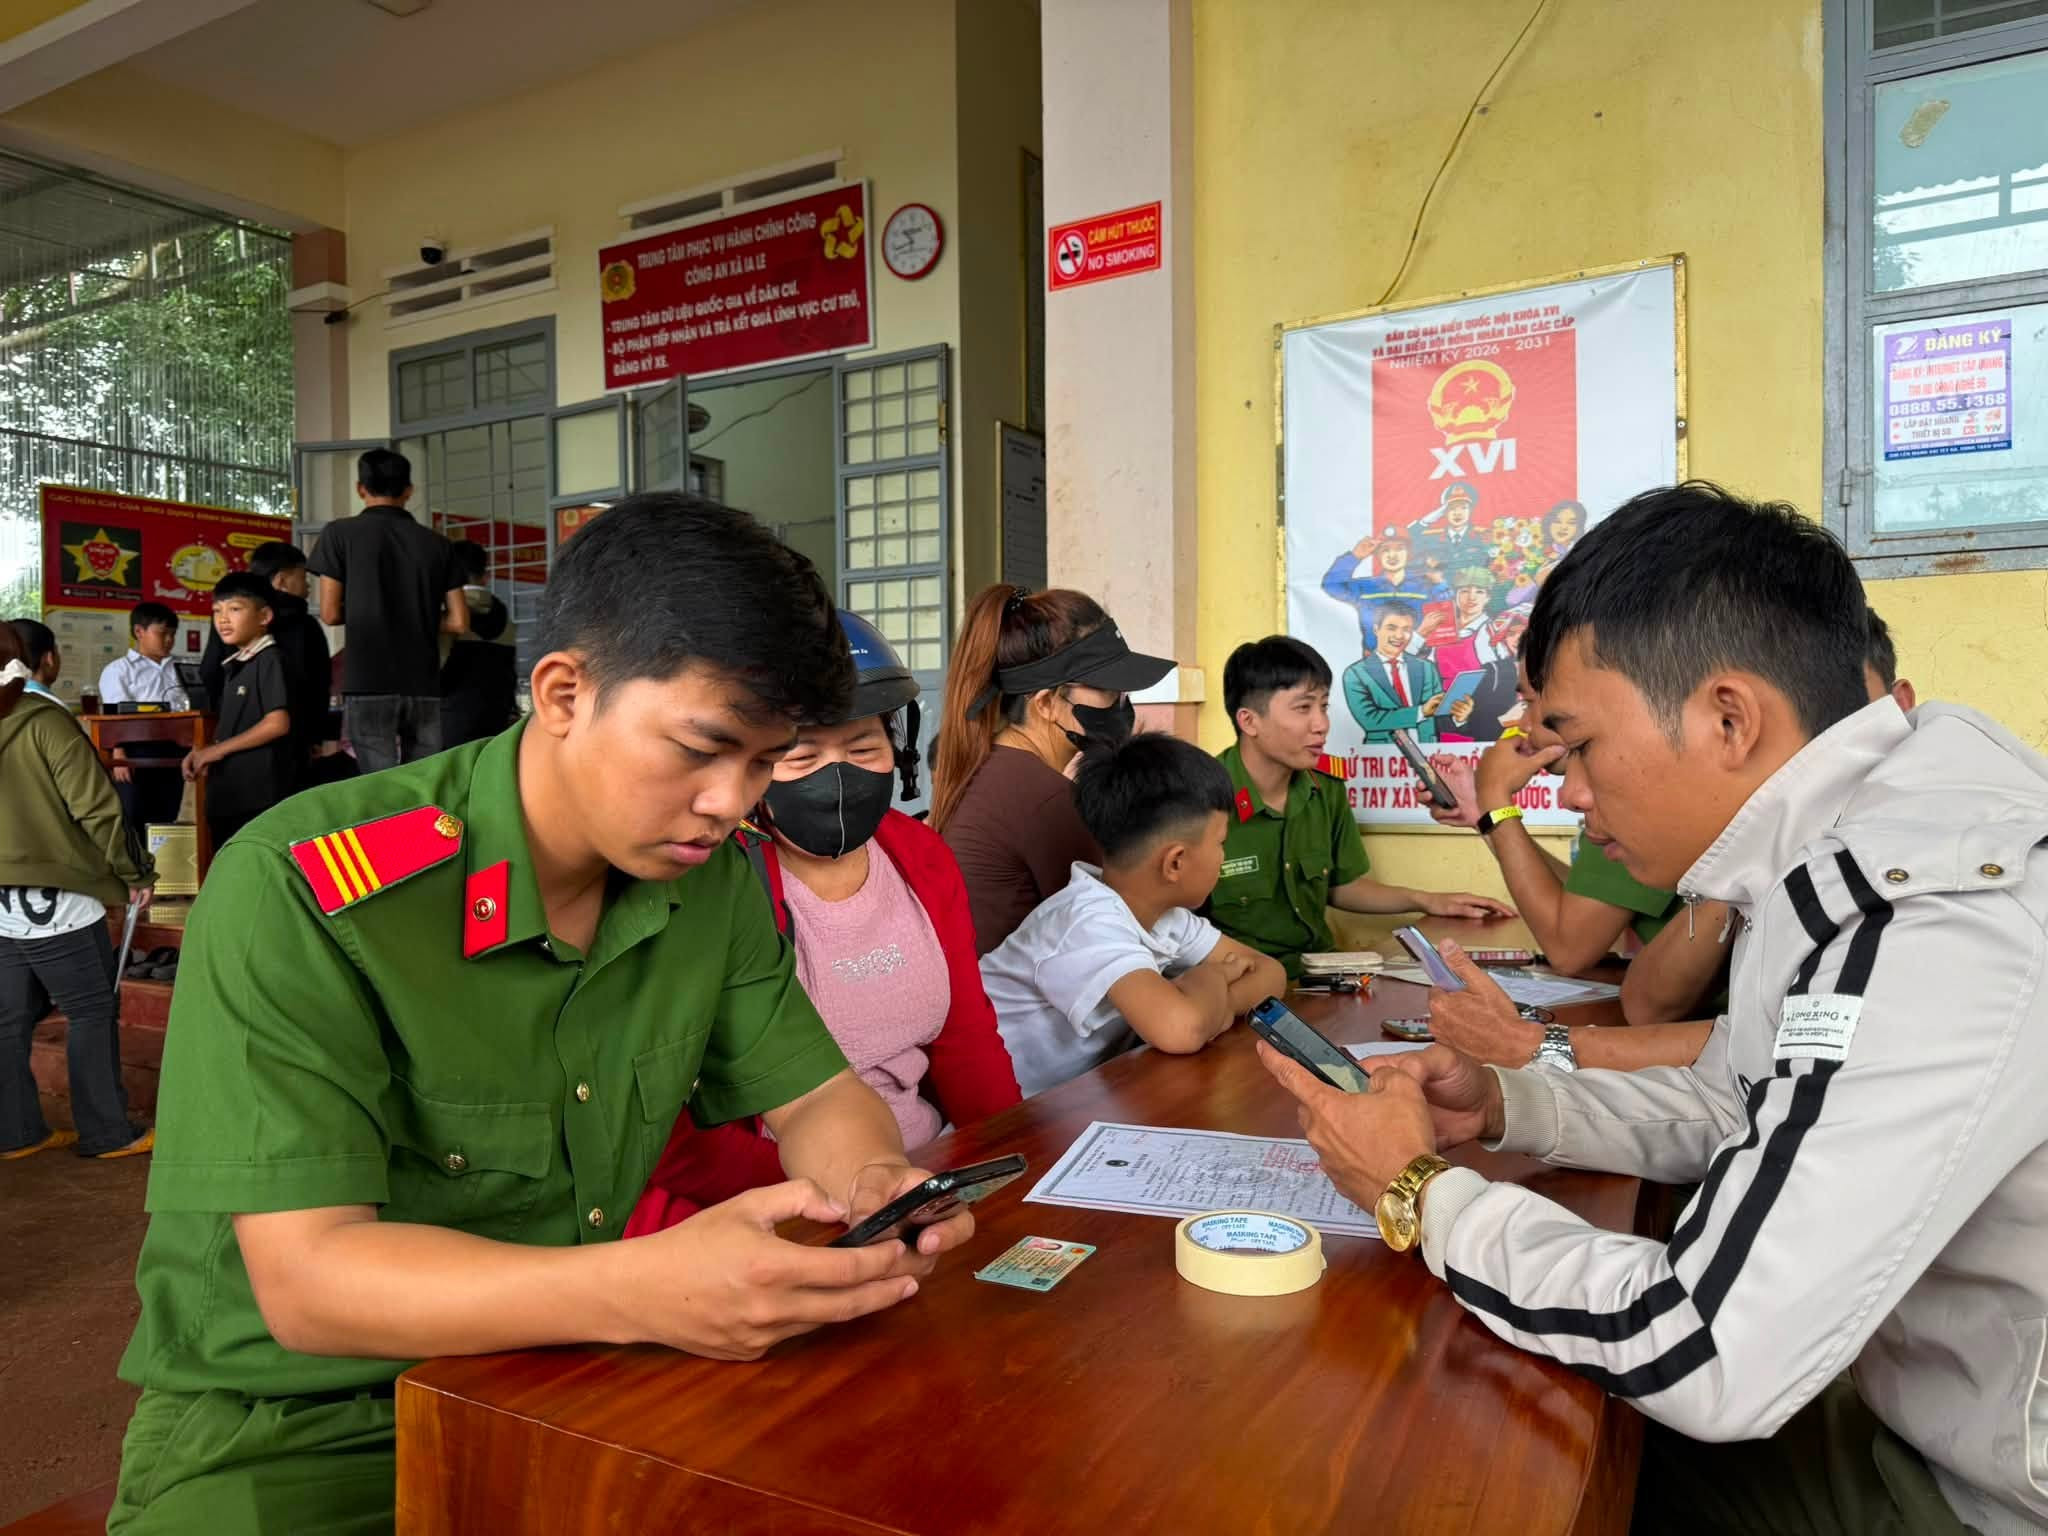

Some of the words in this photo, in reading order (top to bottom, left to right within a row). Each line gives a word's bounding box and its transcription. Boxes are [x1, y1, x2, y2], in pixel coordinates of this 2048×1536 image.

[638, 249, 666, 269] TRUNG
[667, 241, 685, 262] TÂM
[727, 226, 753, 248] HÀNH
[755, 218, 785, 242] CHÍNH
[787, 211, 816, 233] CÔNG
[1088, 255, 1104, 272] NO
[1105, 243, 1155, 267] SMOKING
[686, 265, 713, 286] CÔNG
[714, 262, 728, 279] AN
[641, 311, 660, 328] TÂM
[696, 294, 724, 316] QUỐC
[725, 294, 742, 309] GIA
[758, 283, 779, 302] DÂN
[1543, 304, 1560, 318] XVI
[699, 320, 713, 338] VÀ
[1531, 319, 1552, 332] CÁC
[1464, 343, 1500, 359] 2026
[1515, 335, 1551, 351] 2031
[1428, 438, 1517, 480] XVI
[1361, 757, 1385, 779] TRI
[1361, 787, 1388, 809] TAY
[1226, 1231, 1259, 1239] MASKING
[1259, 1232, 1278, 1241] TAPE
